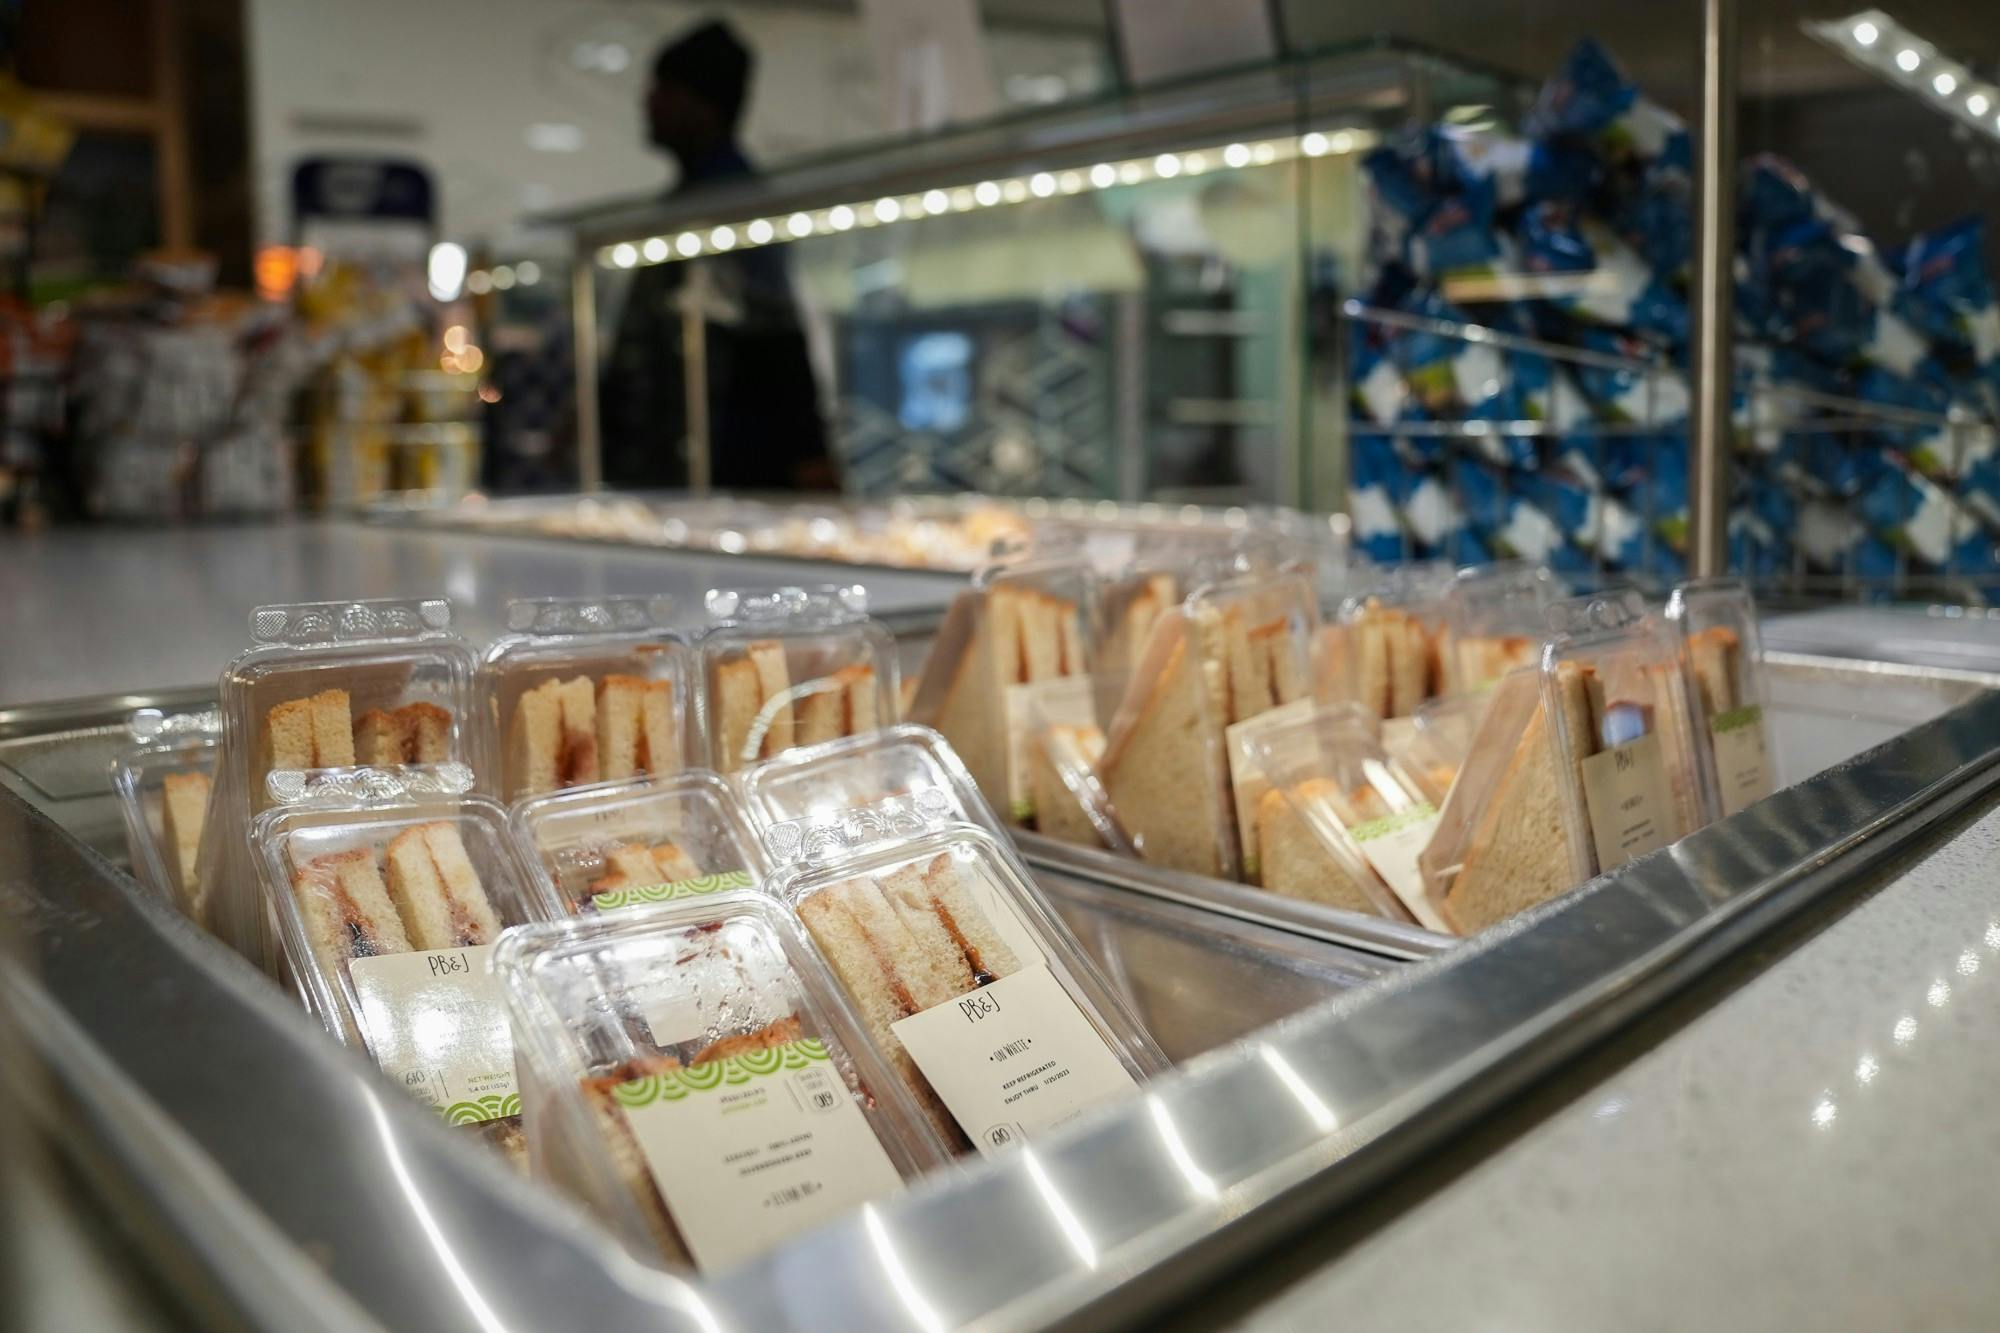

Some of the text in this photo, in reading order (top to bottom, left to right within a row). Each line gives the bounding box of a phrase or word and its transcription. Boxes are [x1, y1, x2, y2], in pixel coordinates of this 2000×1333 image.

[428, 953, 470, 976] PB&J
[959, 991, 1001, 1023] PB&J
[993, 1039, 1029, 1062] ON WHITE
[406, 1070, 425, 1085] 610
[1002, 1060, 1056, 1090] KEEP REFRIGERATED
[1004, 1092, 1022, 1104] ENJOY
[1023, 1084, 1039, 1095] THRU
[991, 1127, 1010, 1146] 610
